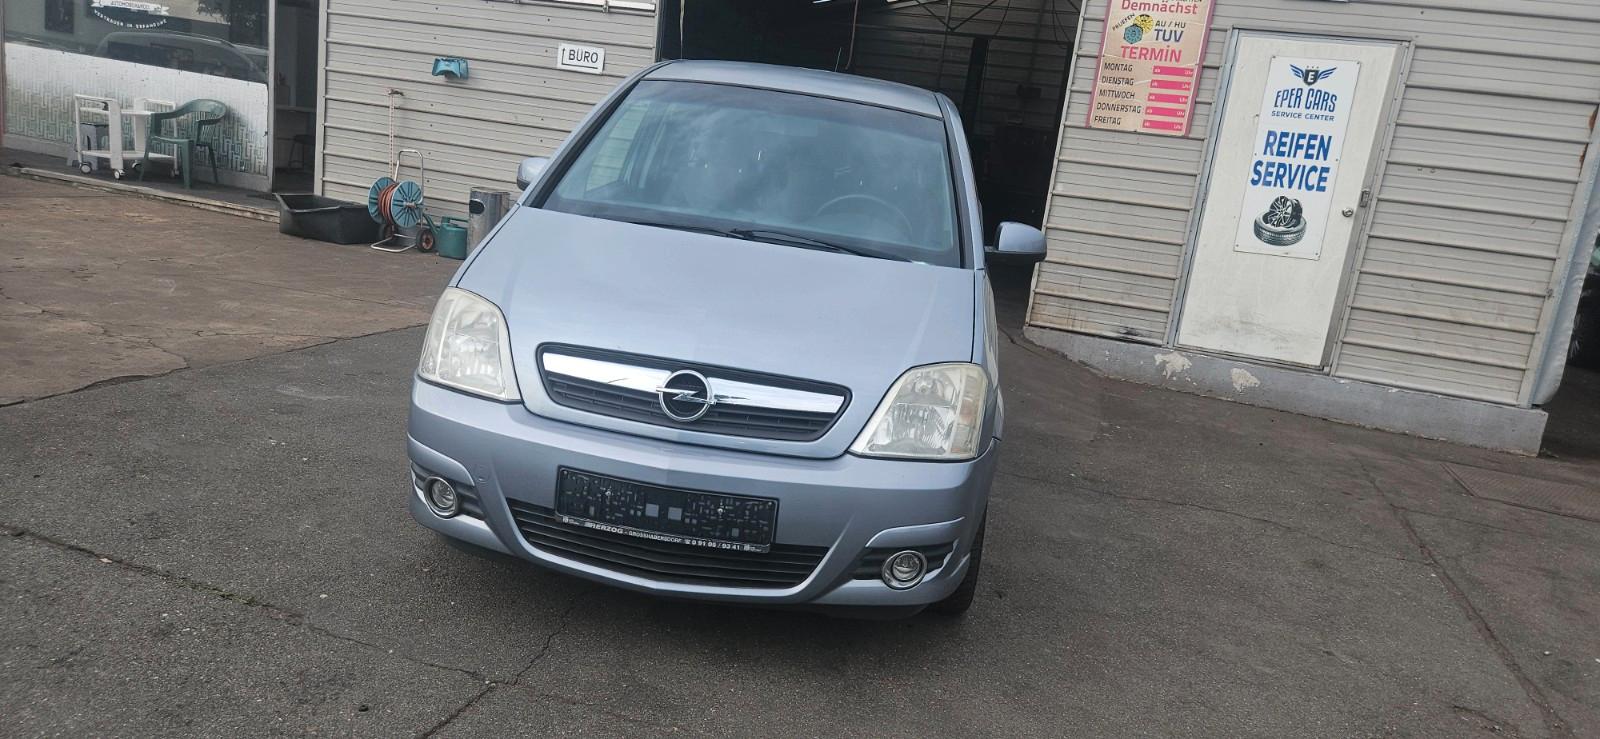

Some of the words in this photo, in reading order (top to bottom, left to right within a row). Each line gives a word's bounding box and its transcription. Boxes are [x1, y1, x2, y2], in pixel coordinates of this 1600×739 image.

[1103, 63, 1133, 72] MONTAG
[1101, 75, 1134, 86] DIENSTAG
[1307, 71, 1315, 83] E
[1098, 89, 1135, 99] MITTWOCH
[1273, 87, 1303, 109] EPER
[1304, 88, 1338, 113] CARS
[1096, 102, 1142, 114] DONNERSTAG
[1094, 115, 1121, 126] FREITAG
[1271, 110, 1302, 119] SERVICE
[1304, 113, 1335, 122] CENTER
[1263, 130, 1332, 161] REIFEN
[1250, 160, 1330, 192] SERVICE
